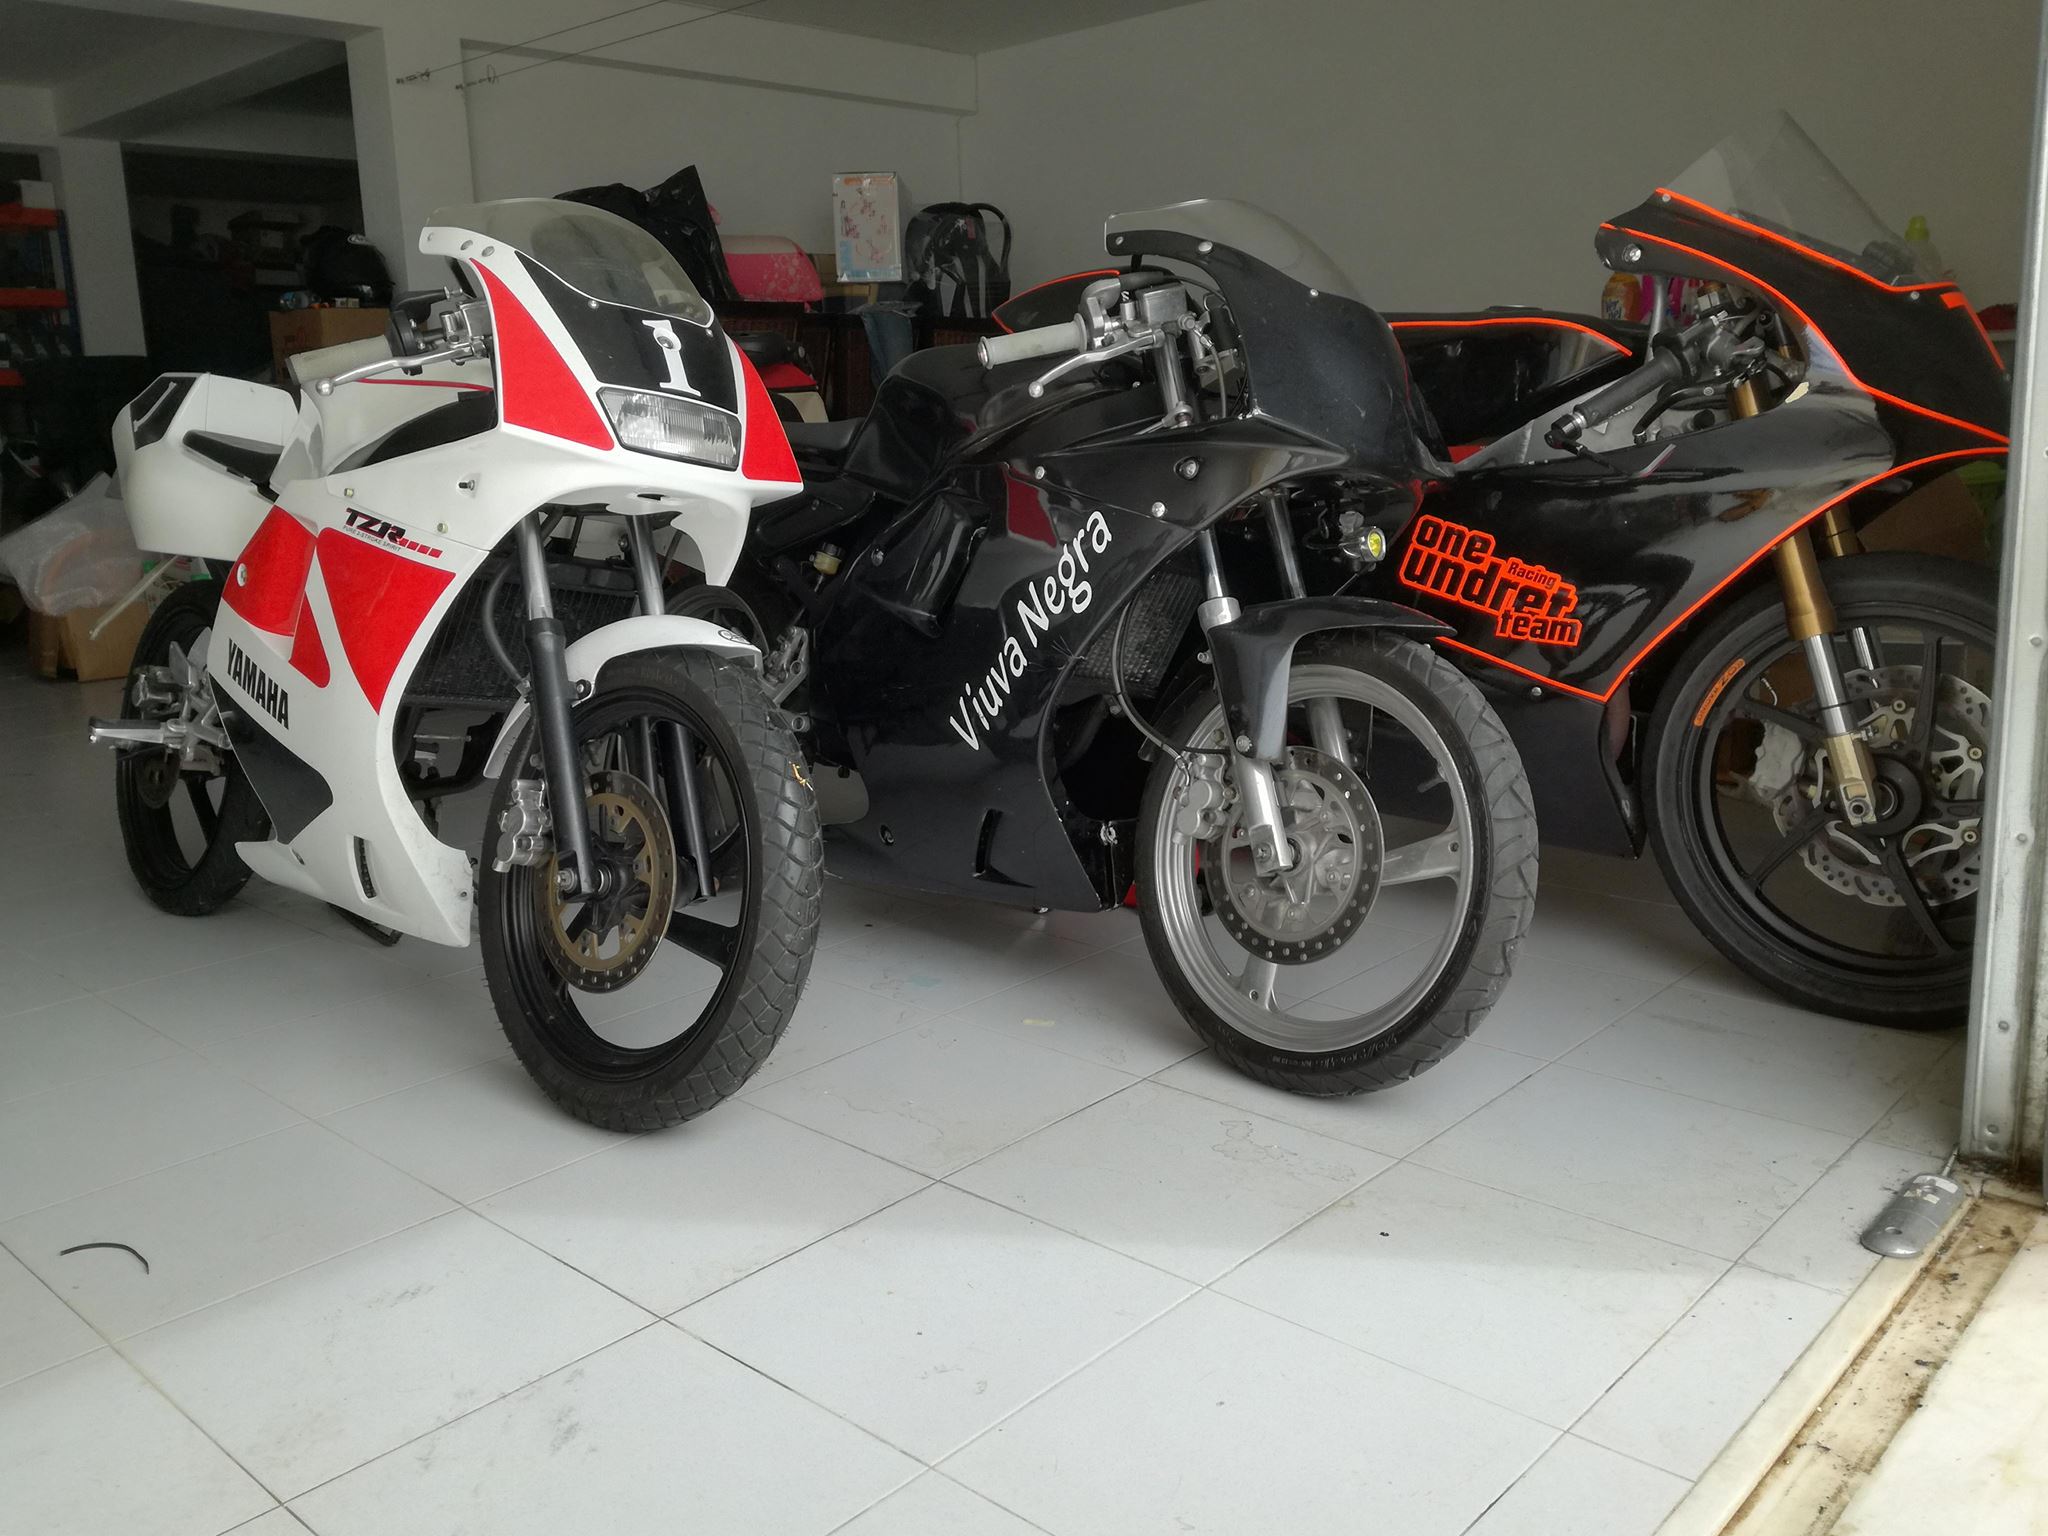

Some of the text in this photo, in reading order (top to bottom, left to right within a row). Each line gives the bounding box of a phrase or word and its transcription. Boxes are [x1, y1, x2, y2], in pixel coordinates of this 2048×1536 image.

[641, 319, 702, 397] 1
[346, 507, 407, 544] TZR
[1414, 517, 1494, 565] one
[1402, 548, 1576, 617] undret
[1507, 561, 1557, 589] Racing
[949, 510, 1113, 751] Viuva Negra
[1500, 609, 1579, 643] team
[227, 637, 289, 731] YAMAHA
